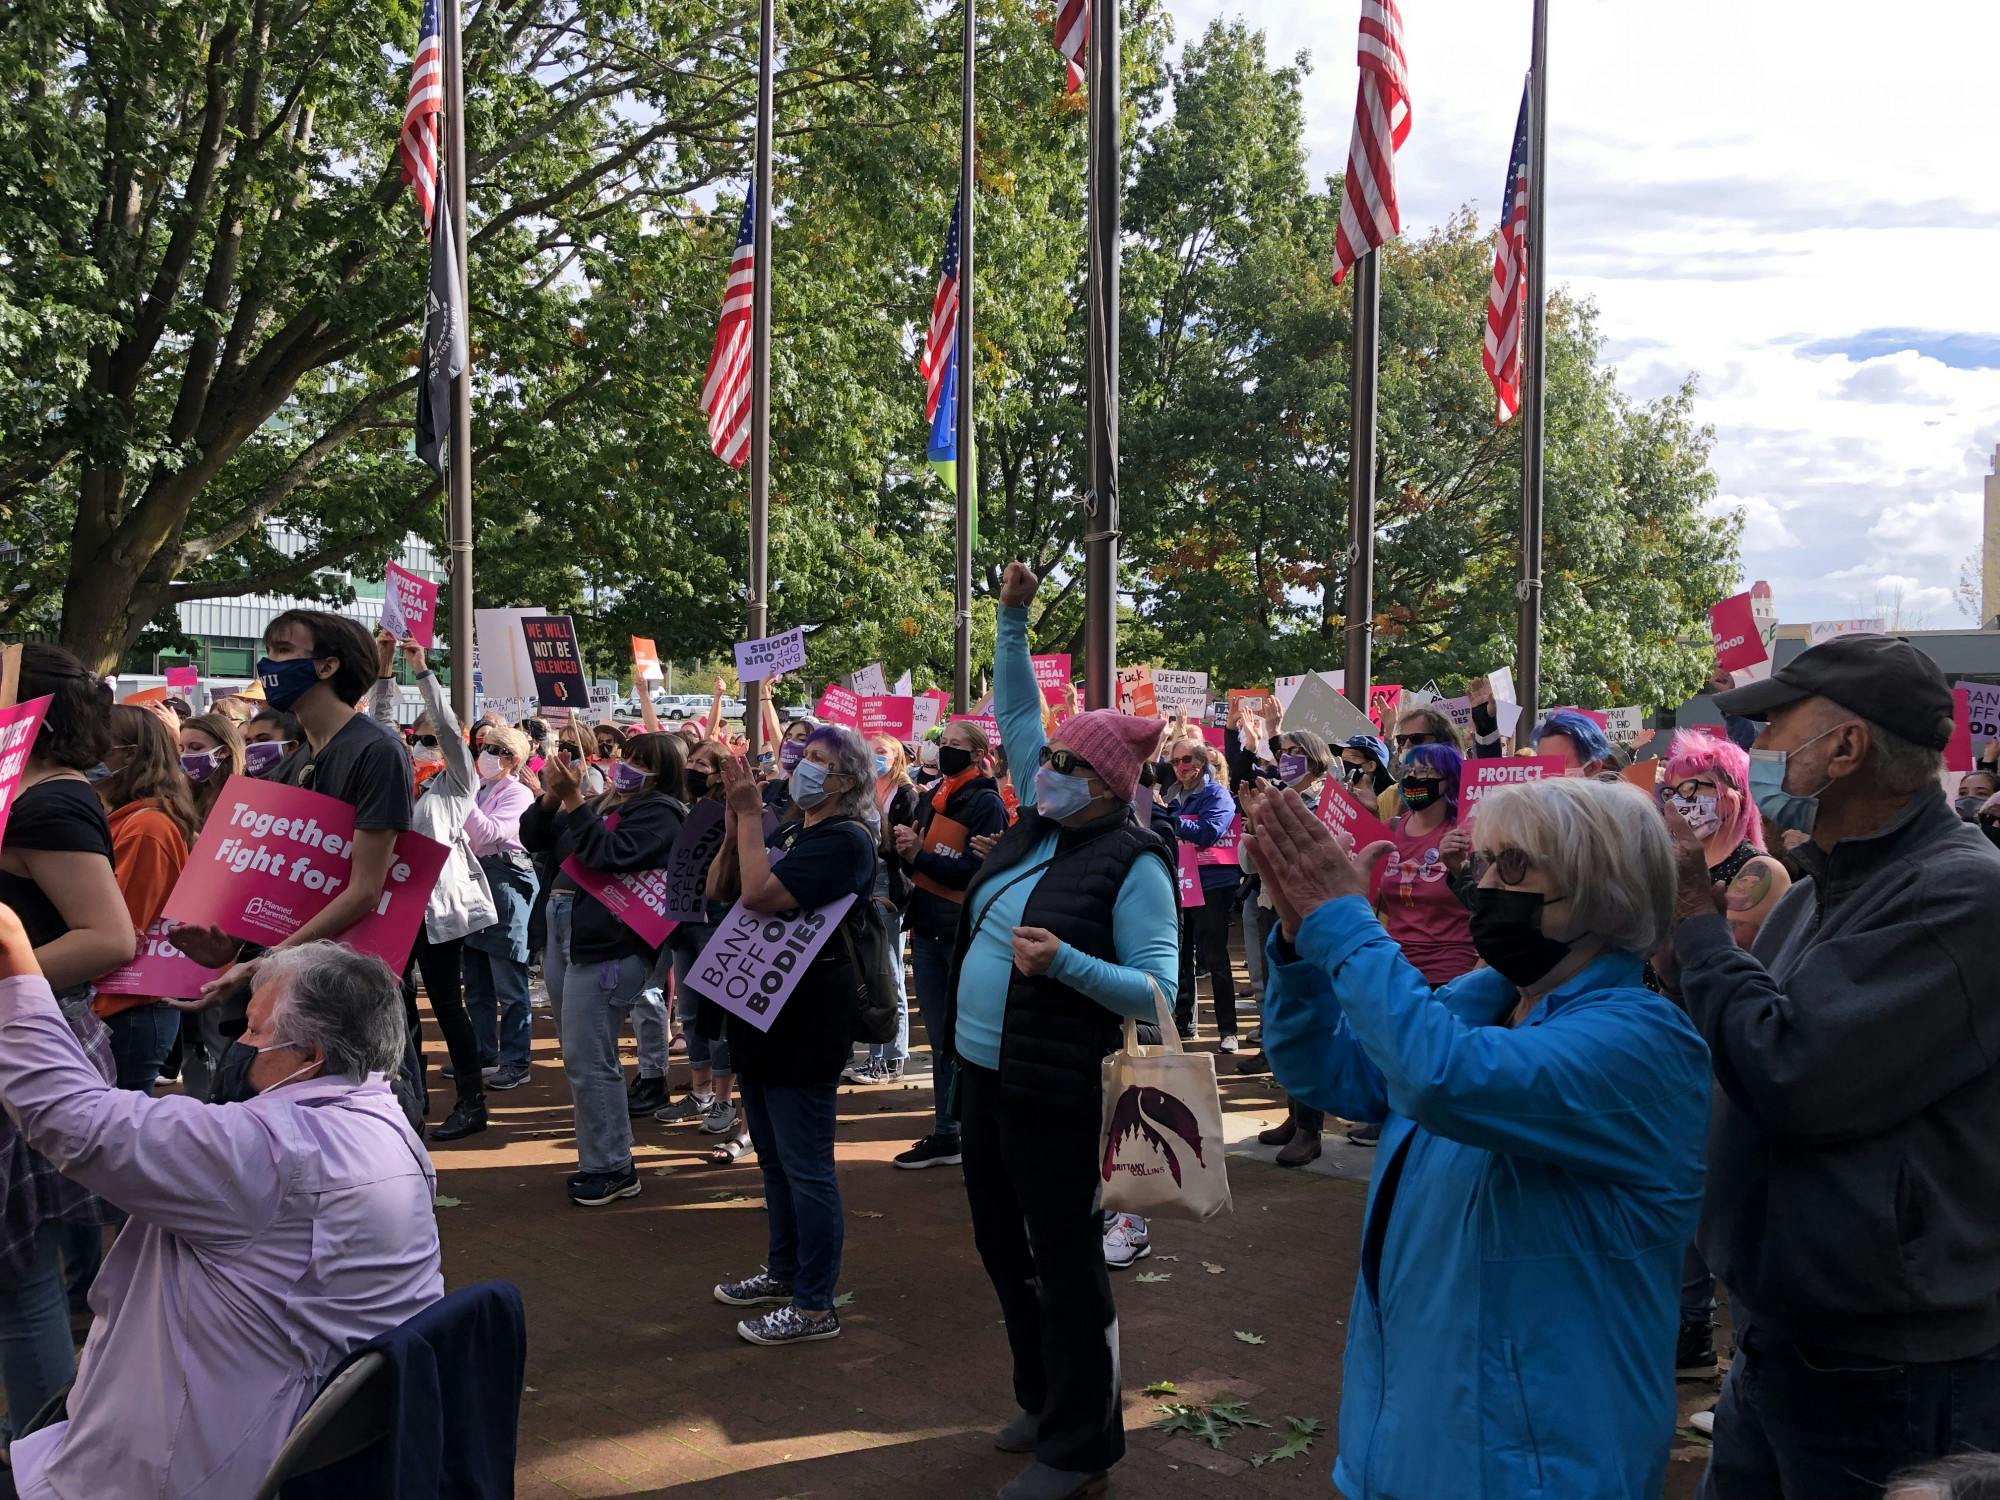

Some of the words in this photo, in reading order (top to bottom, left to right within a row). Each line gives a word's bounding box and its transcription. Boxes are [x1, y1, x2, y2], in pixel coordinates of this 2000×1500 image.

[526, 623, 543, 638] WE
[545, 623, 571, 638] WILL
[533, 641, 554, 658] NOT
[557, 641, 572, 658] BE
[750, 632, 799, 654] BODIES
[777, 643, 800, 659] OFF
[534, 660, 578, 674] SILENCED
[744, 653, 775, 666] OUR
[769, 652, 801, 673] BANS
[1158, 673, 1196, 685] DEFEND
[483, 699, 505, 709] REAL
[1191, 698, 1204, 707] MY
[1451, 707, 1471, 717] OUR
[1616, 720, 1631, 729] END
[1608, 729, 1640, 742] BORTION
[1478, 765, 1544, 783] PROTECT
[1327, 800, 1346, 824] WITH
[1333, 793, 1358, 820] STAND
[214, 838, 287, 877] Fight
[288, 856, 342, 896] for
[669, 848, 691, 912] BANS
[680, 865, 696, 912] OFF
[263, 900, 293, 915] Planned
[260, 907, 301, 927] Parenthood
[700, 912, 760, 988] BANS
[725, 943, 764, 1000] OFF
[745, 910, 827, 1017] BODIES
[1112, 1162, 1146, 1172] BRITTANY
[1131, 1166, 1166, 1177] COLLINS
